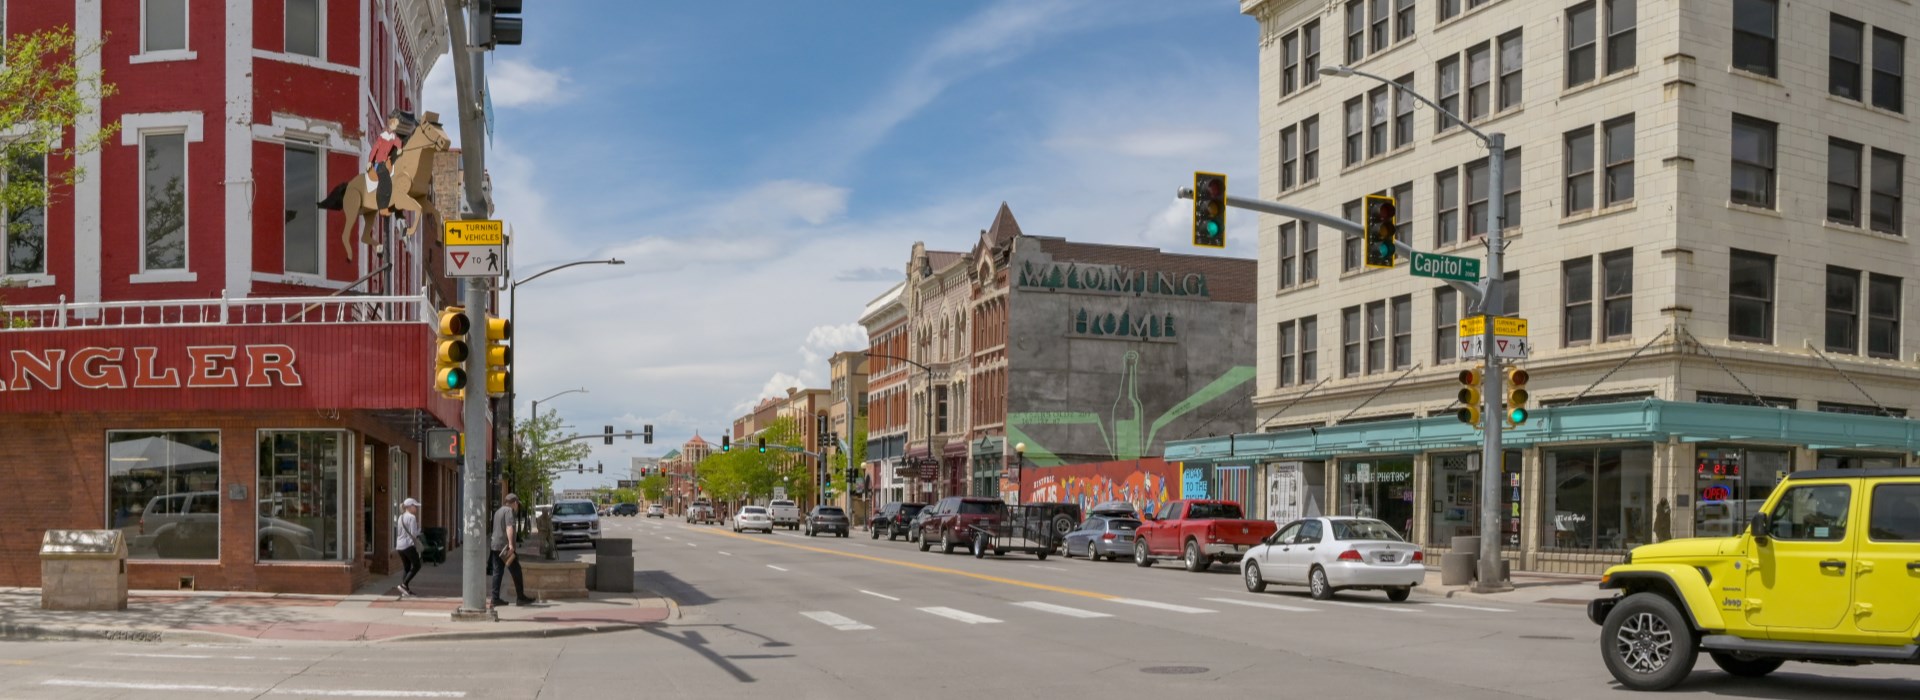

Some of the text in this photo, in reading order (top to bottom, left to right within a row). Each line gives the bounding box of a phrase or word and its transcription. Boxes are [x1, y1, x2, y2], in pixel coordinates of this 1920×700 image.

[1414, 254, 1462, 277] Capitol
[1022, 263, 1204, 297] WYOMING
[1074, 311, 1177, 339] HOME
[0, 345, 302, 391] NGLER
[450, 435, 457, 454] 2
[1034, 475, 1054, 488] HISTORIC
[1377, 472, 1404, 482] PHOTOS
[1186, 482, 1207, 492] TO THE
[1704, 488, 1728, 501] OPEN
[1511, 486, 1520, 532] ART
[1722, 597, 1742, 607] Jeep
